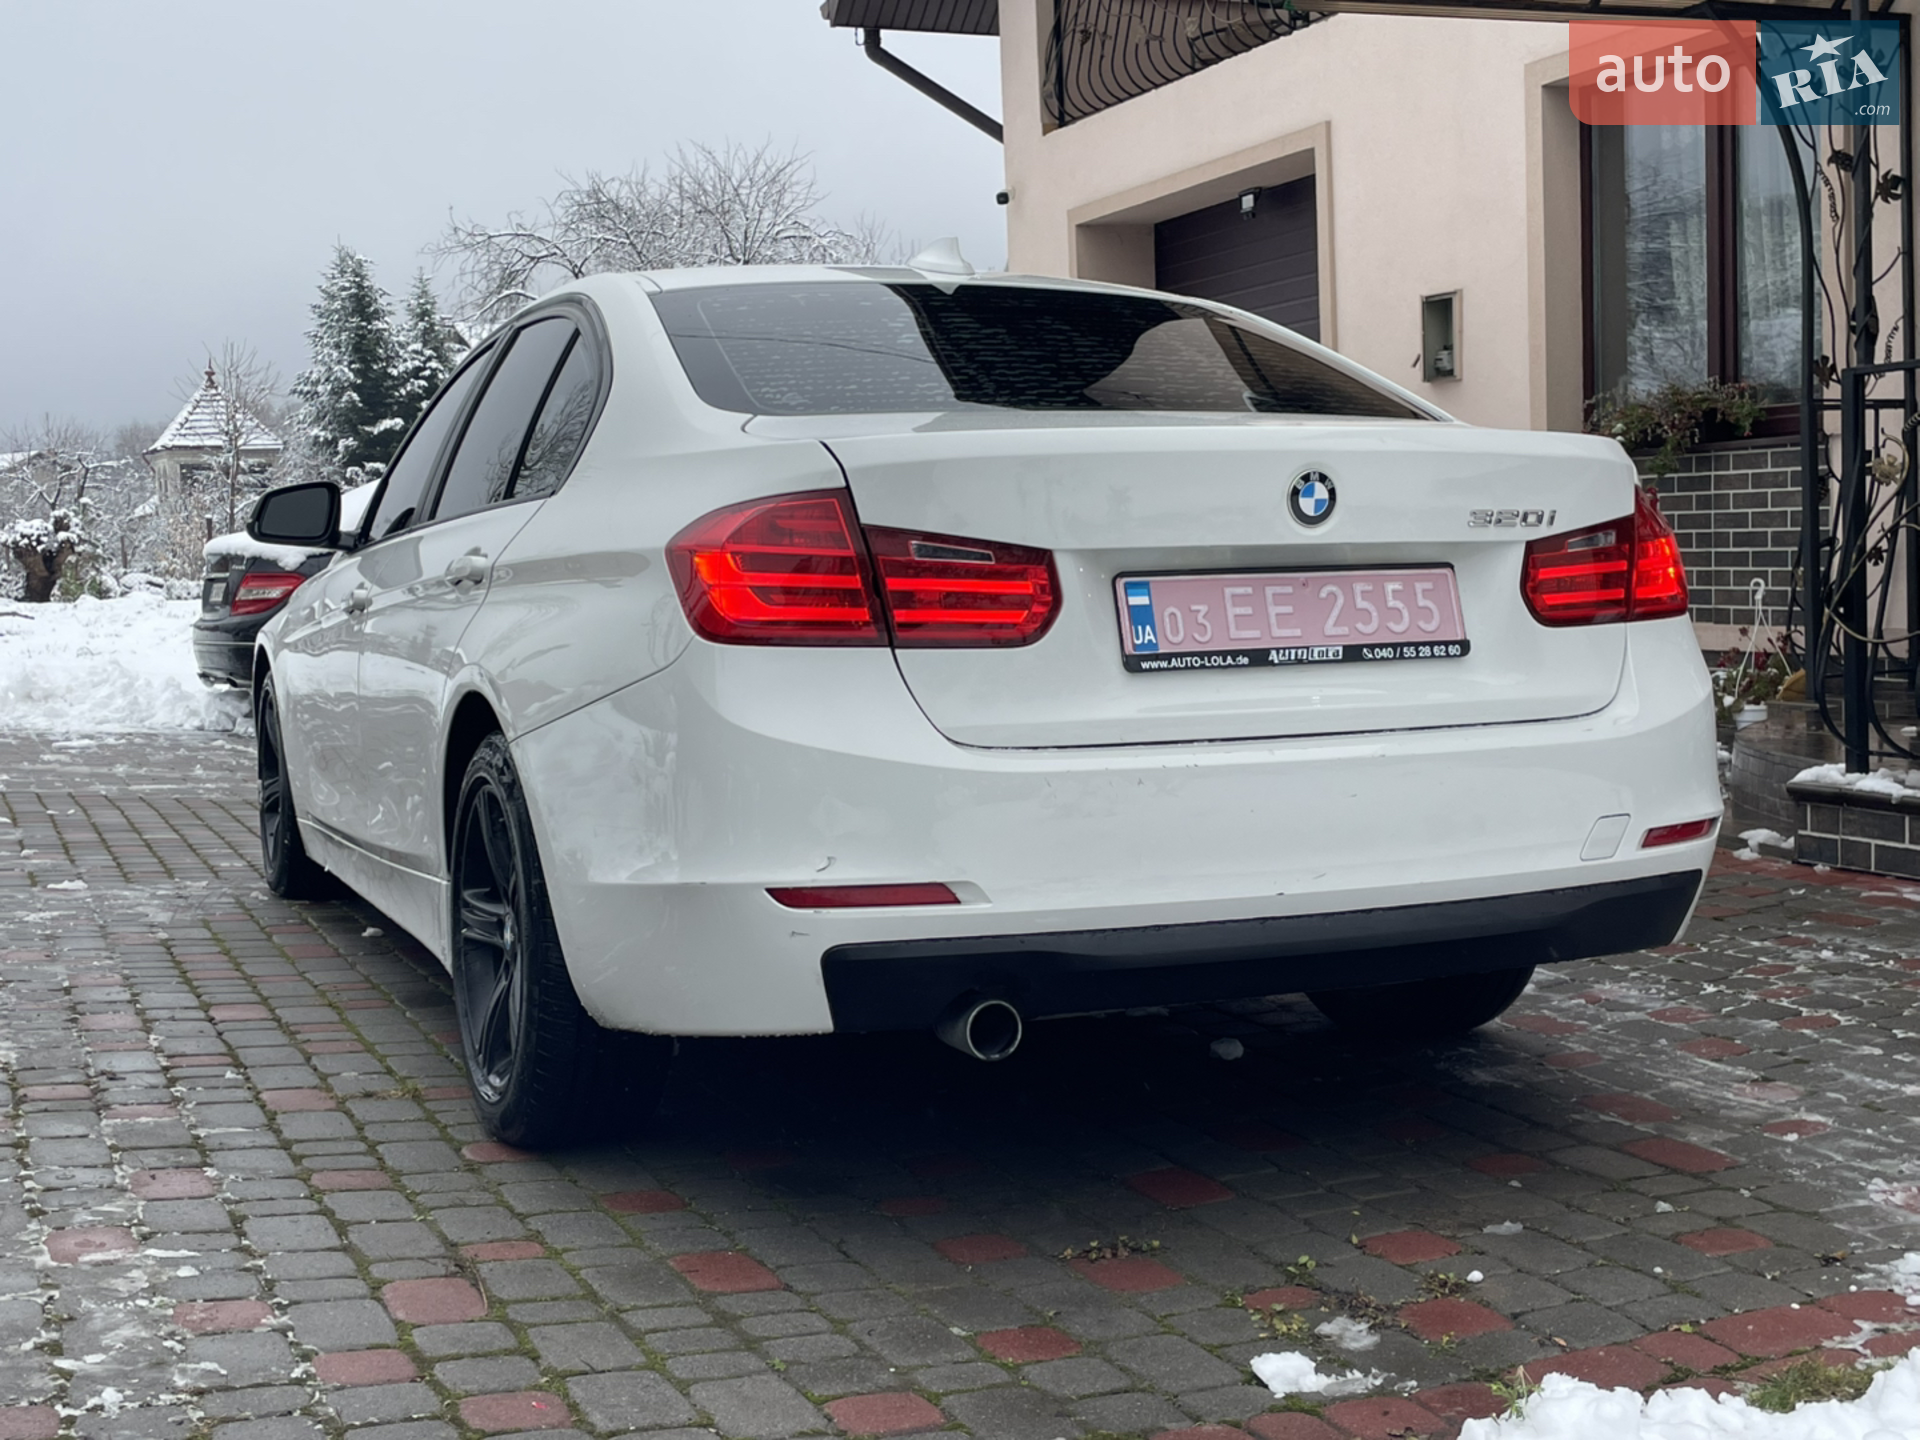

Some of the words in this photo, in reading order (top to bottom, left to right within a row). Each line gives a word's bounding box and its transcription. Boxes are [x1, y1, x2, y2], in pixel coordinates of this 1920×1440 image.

[1467, 510, 1557, 528] 320i
[1163, 604, 1213, 645] 03
[1223, 585, 1302, 641] EE
[1318, 580, 1441, 637] 2555
[1132, 624, 1157, 645] UA
[1374, 647, 1394, 659] 040
[1403, 646, 1417, 658] 55
[1418, 645, 1432, 657] 28
[1433, 644, 1447, 656] 62
[1448, 644, 1461, 656] 60
[1140, 655, 1250, 670] www.AUTO-LOLA.de
